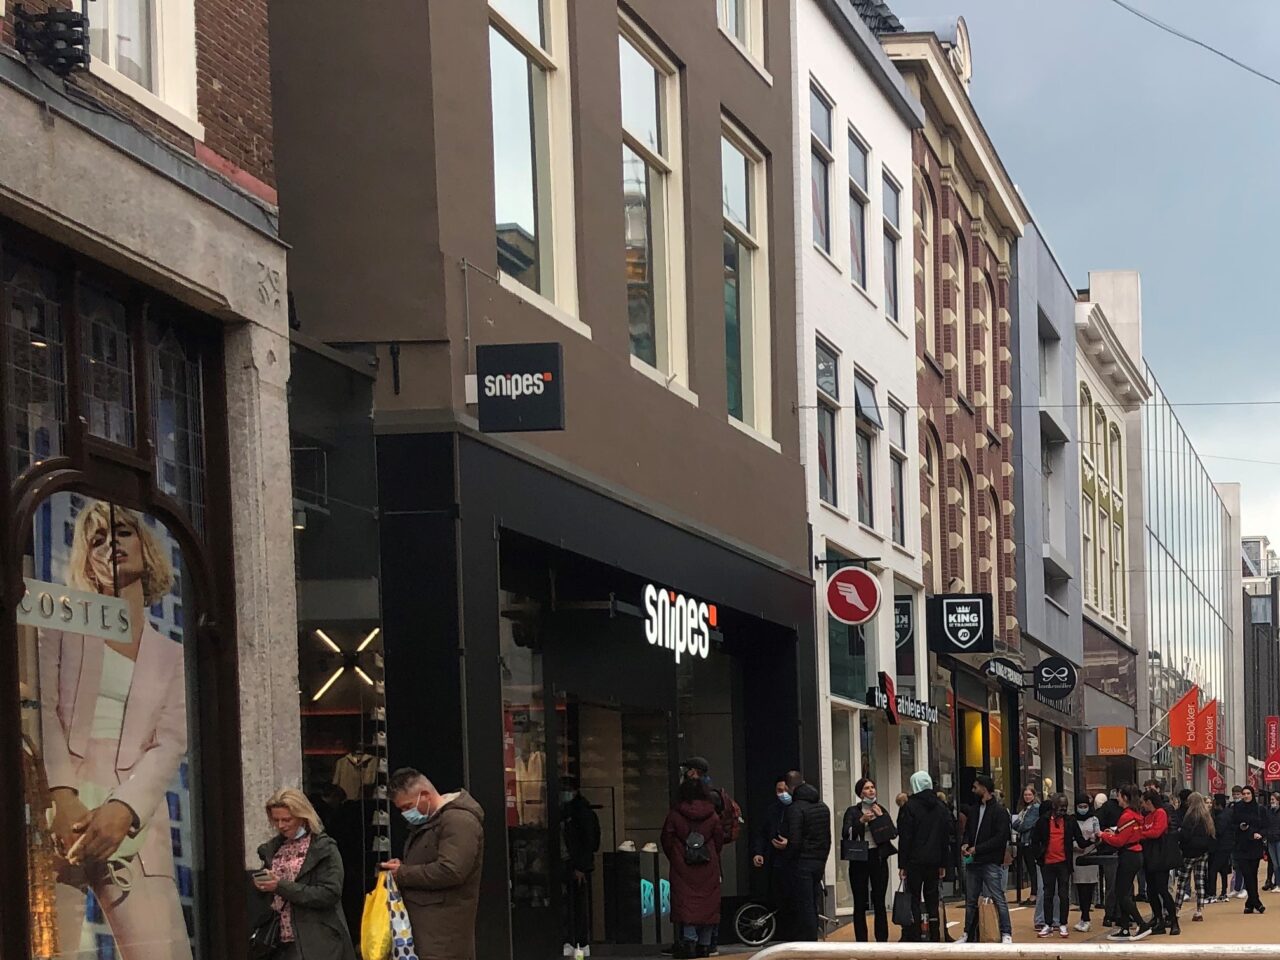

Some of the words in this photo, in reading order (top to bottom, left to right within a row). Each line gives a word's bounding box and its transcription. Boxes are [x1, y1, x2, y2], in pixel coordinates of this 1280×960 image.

[484, 372, 545, 400] snipes
[20, 590, 129, 632] COSTES
[645, 585, 709, 664] snipes
[948, 613, 978, 622] KING
[875, 687, 888, 709] the
